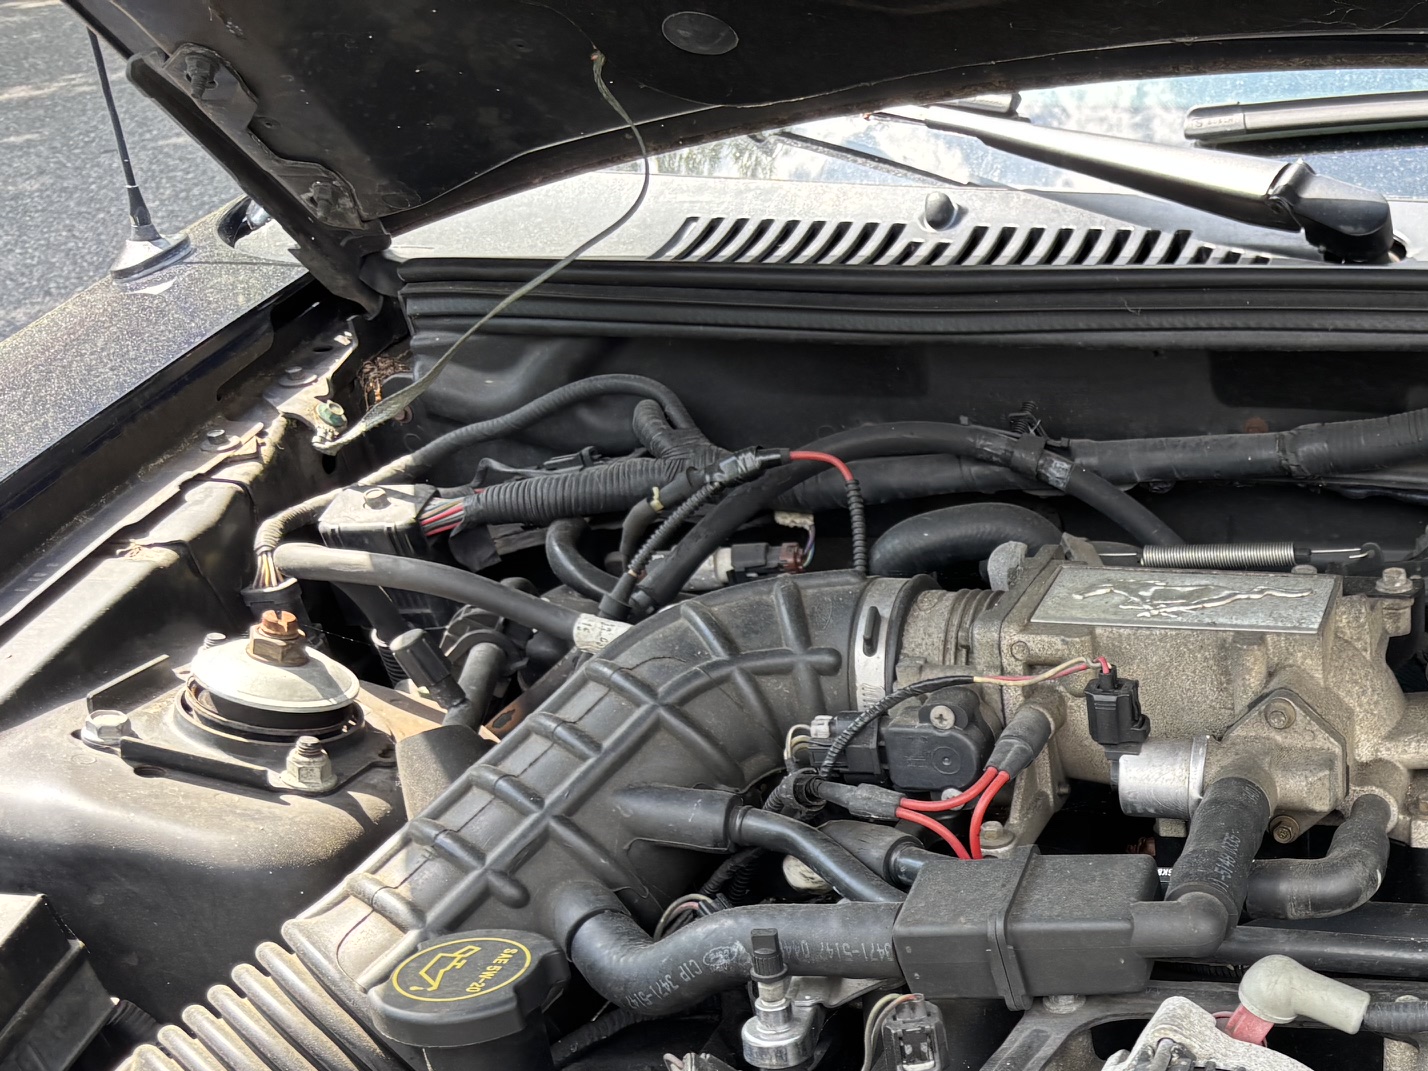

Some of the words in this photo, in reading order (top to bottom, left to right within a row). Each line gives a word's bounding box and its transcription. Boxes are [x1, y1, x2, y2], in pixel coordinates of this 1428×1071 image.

[493, 948, 519, 965] SAE
[466, 965, 503, 993] 5W-20
[680, 958, 703, 982] CIP
